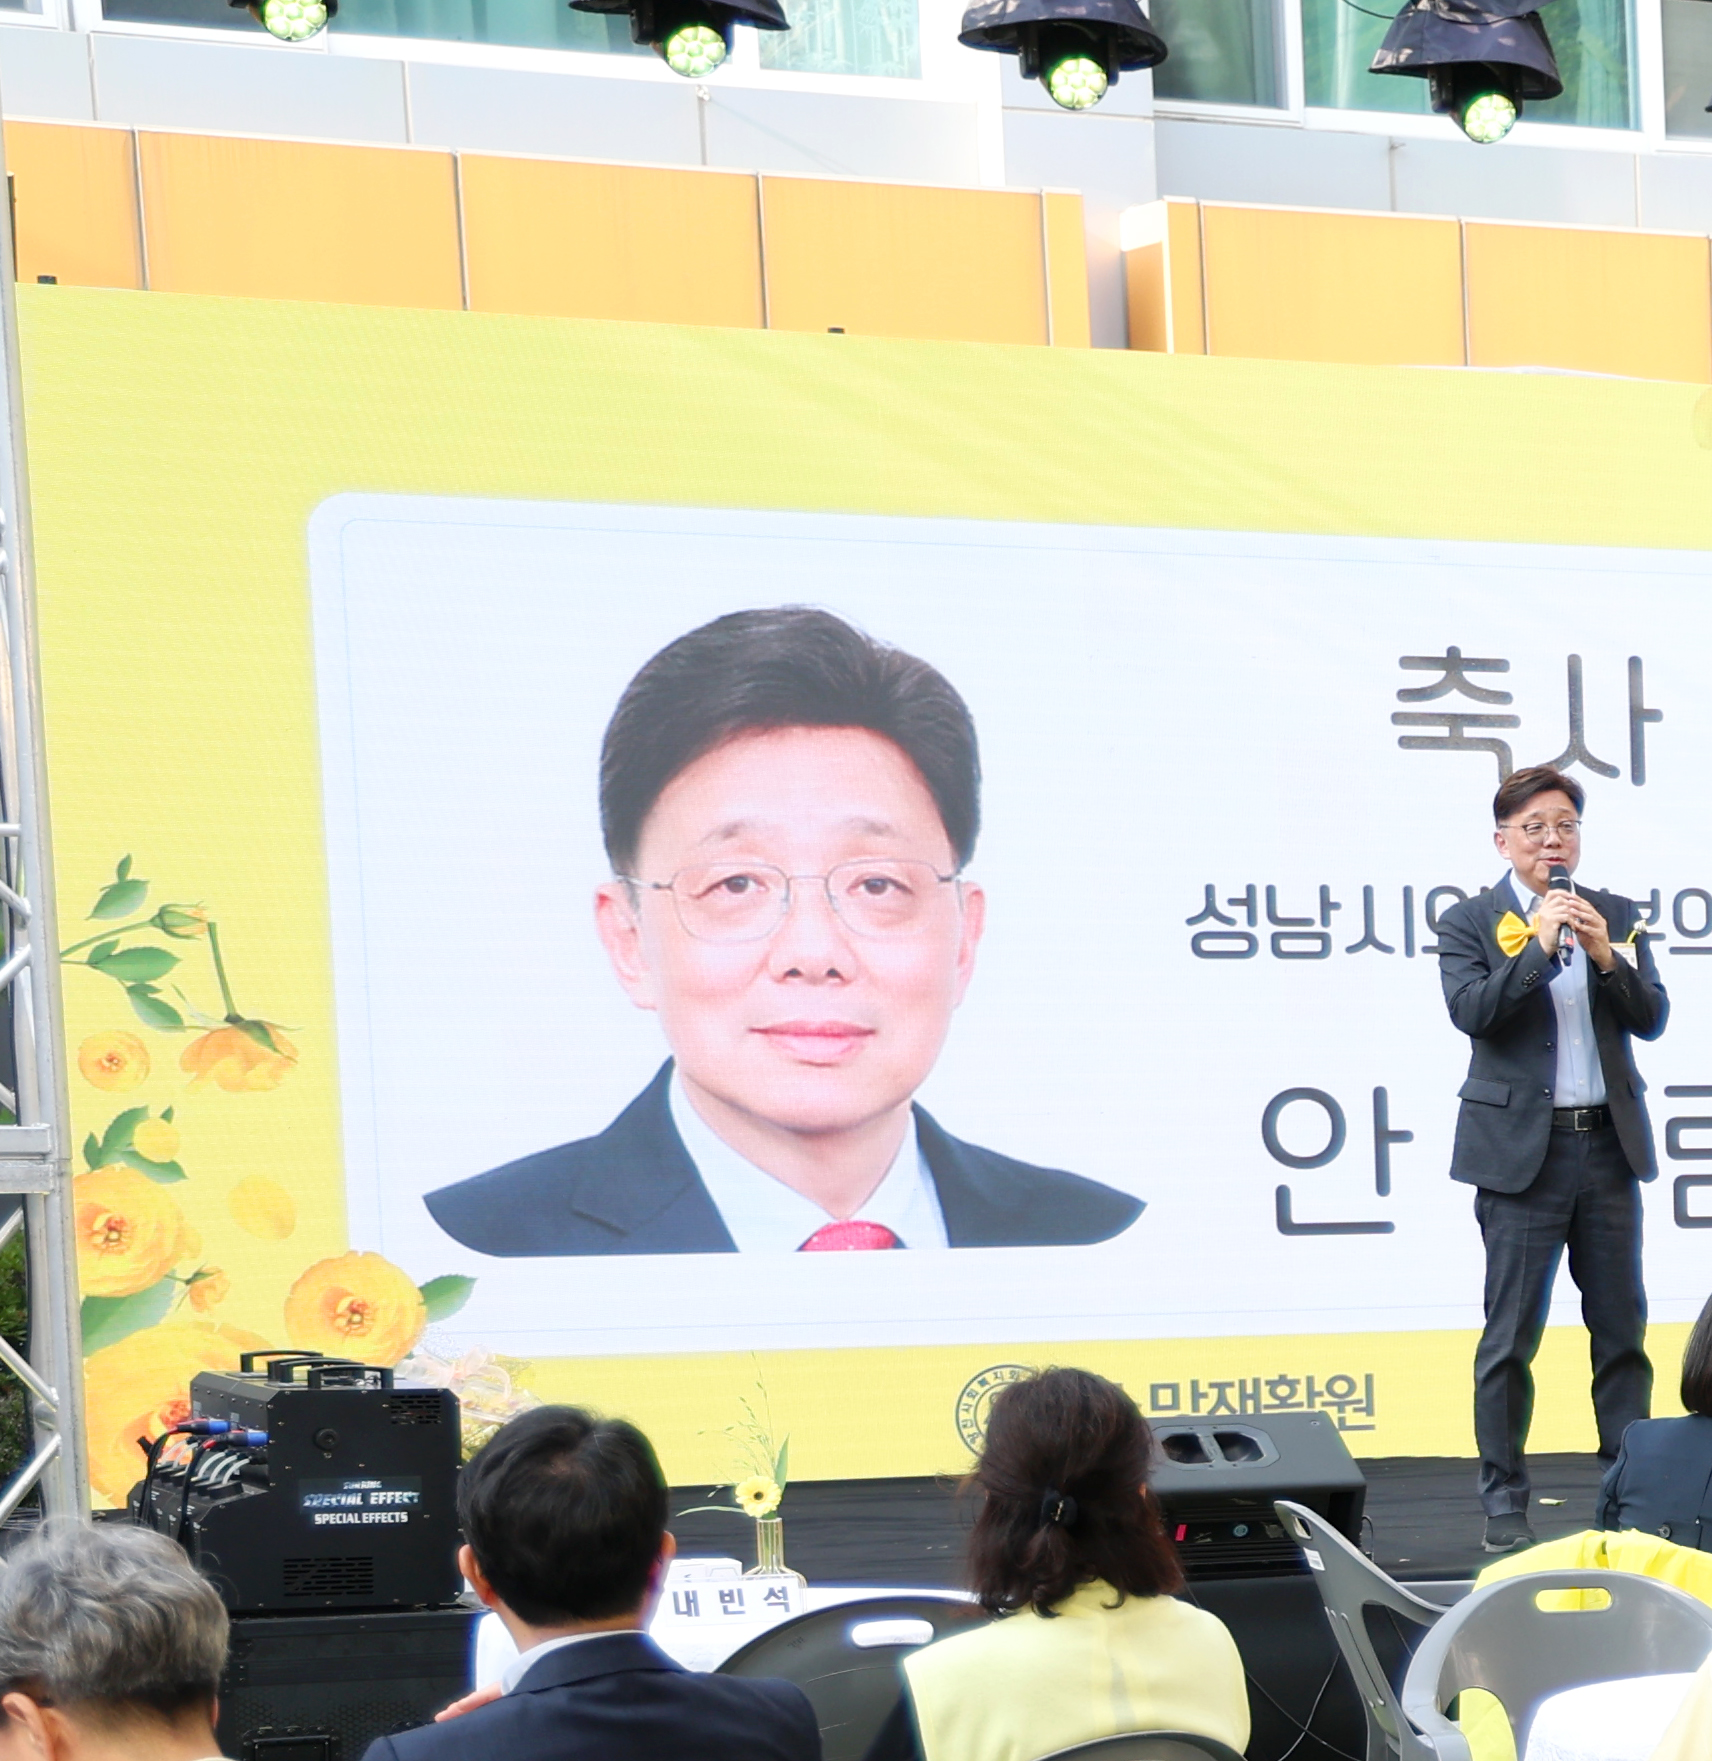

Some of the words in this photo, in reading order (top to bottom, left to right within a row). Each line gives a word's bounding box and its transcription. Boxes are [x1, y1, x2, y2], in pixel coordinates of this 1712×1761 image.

[1391, 646, 1664, 787] 축사
[314, 1513, 361, 1525] SPECIAL
[362, 1511, 409, 1523] EFFECTS
